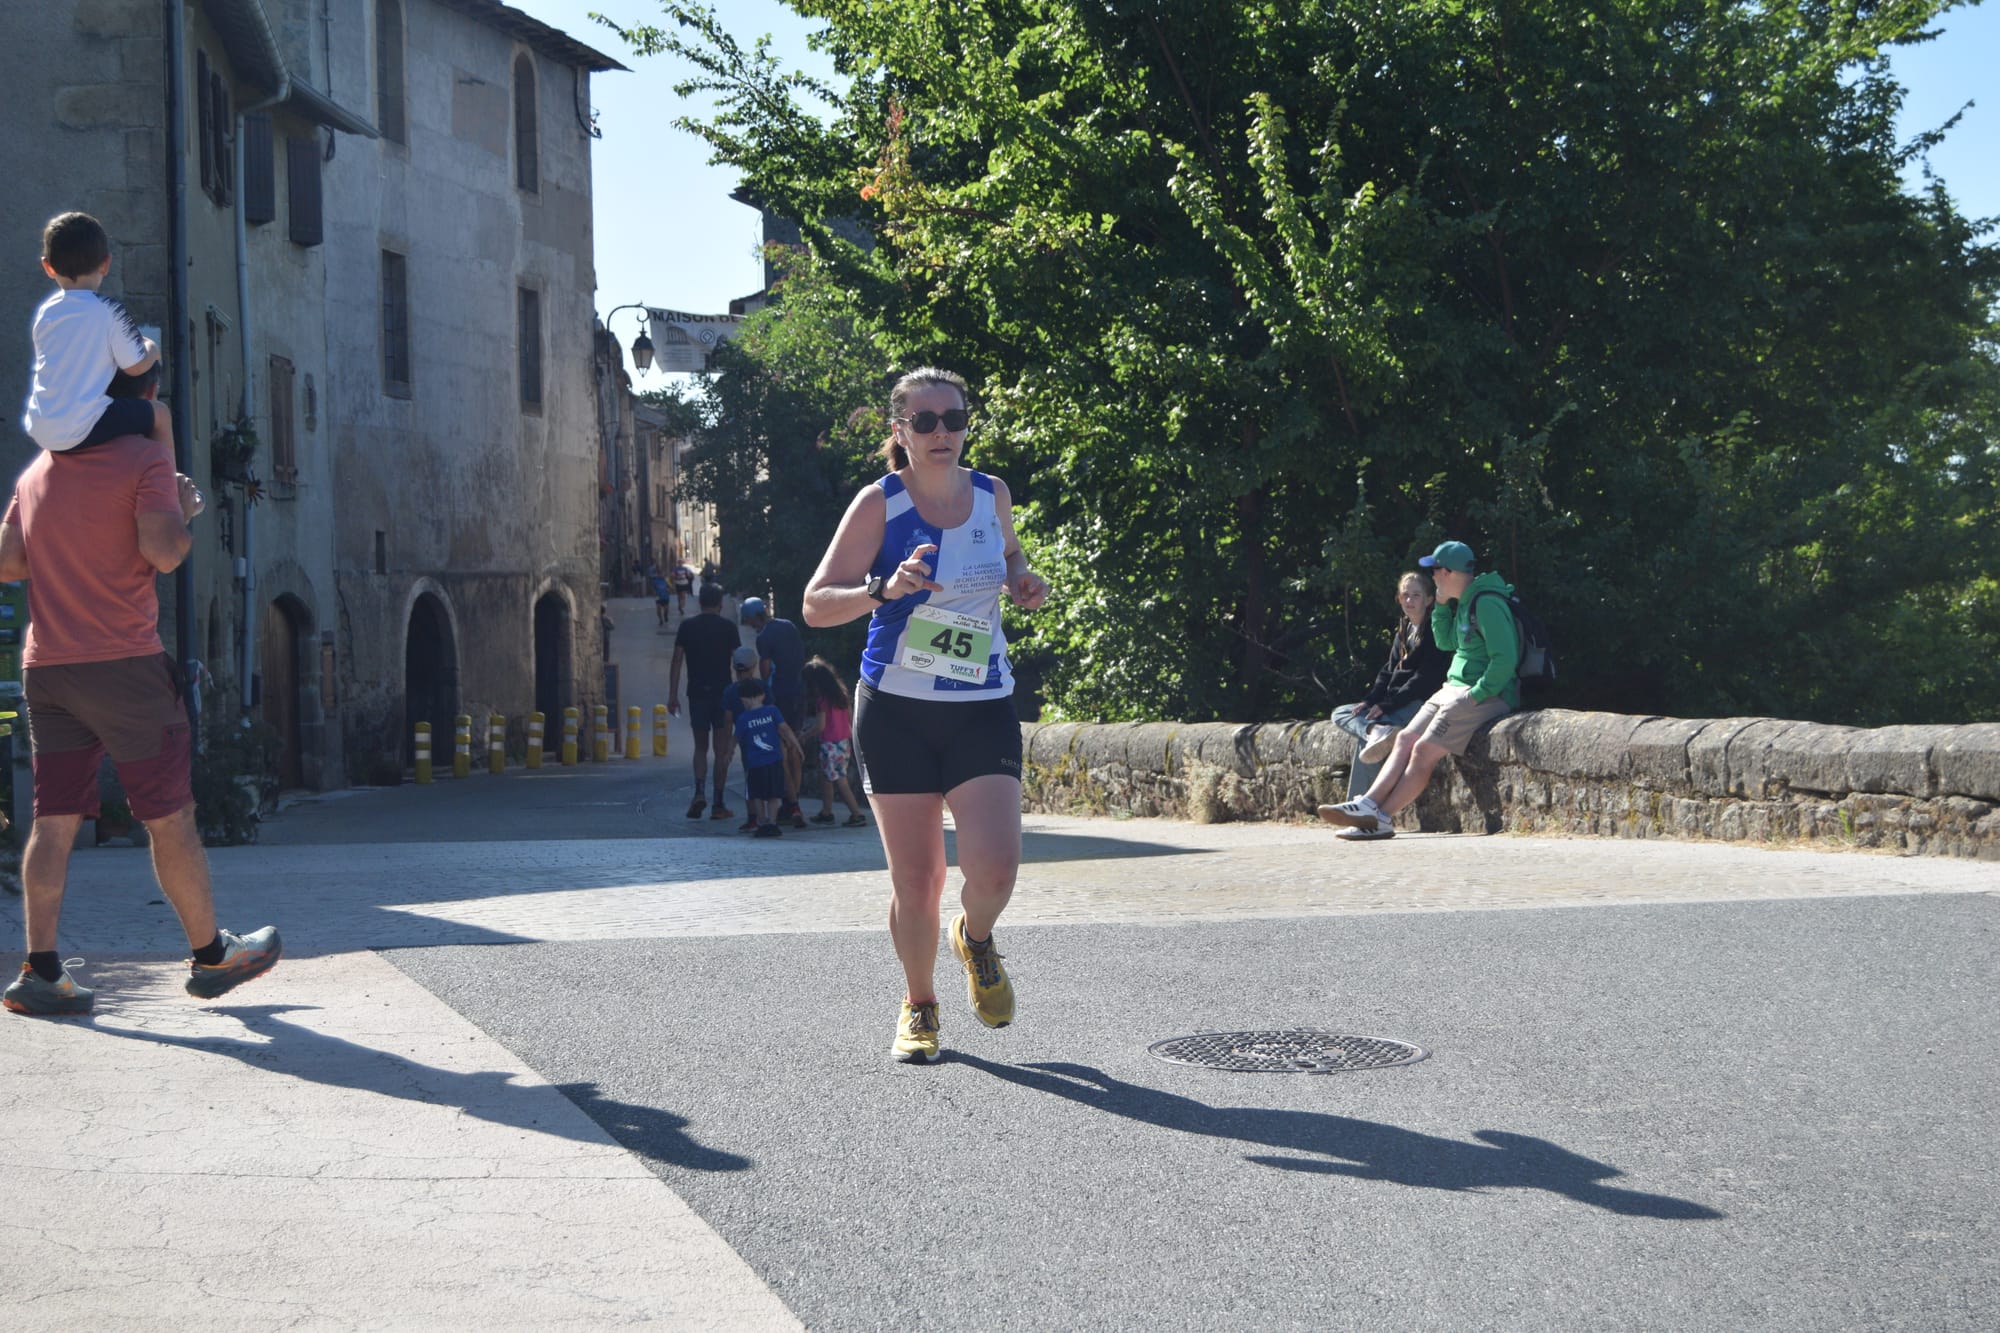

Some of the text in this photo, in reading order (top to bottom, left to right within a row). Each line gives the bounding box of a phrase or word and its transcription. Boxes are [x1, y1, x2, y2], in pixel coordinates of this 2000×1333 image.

[652, 311, 715, 323] MAISON
[930, 628, 973, 658] 45
[748, 715, 773, 728] ETHAN
